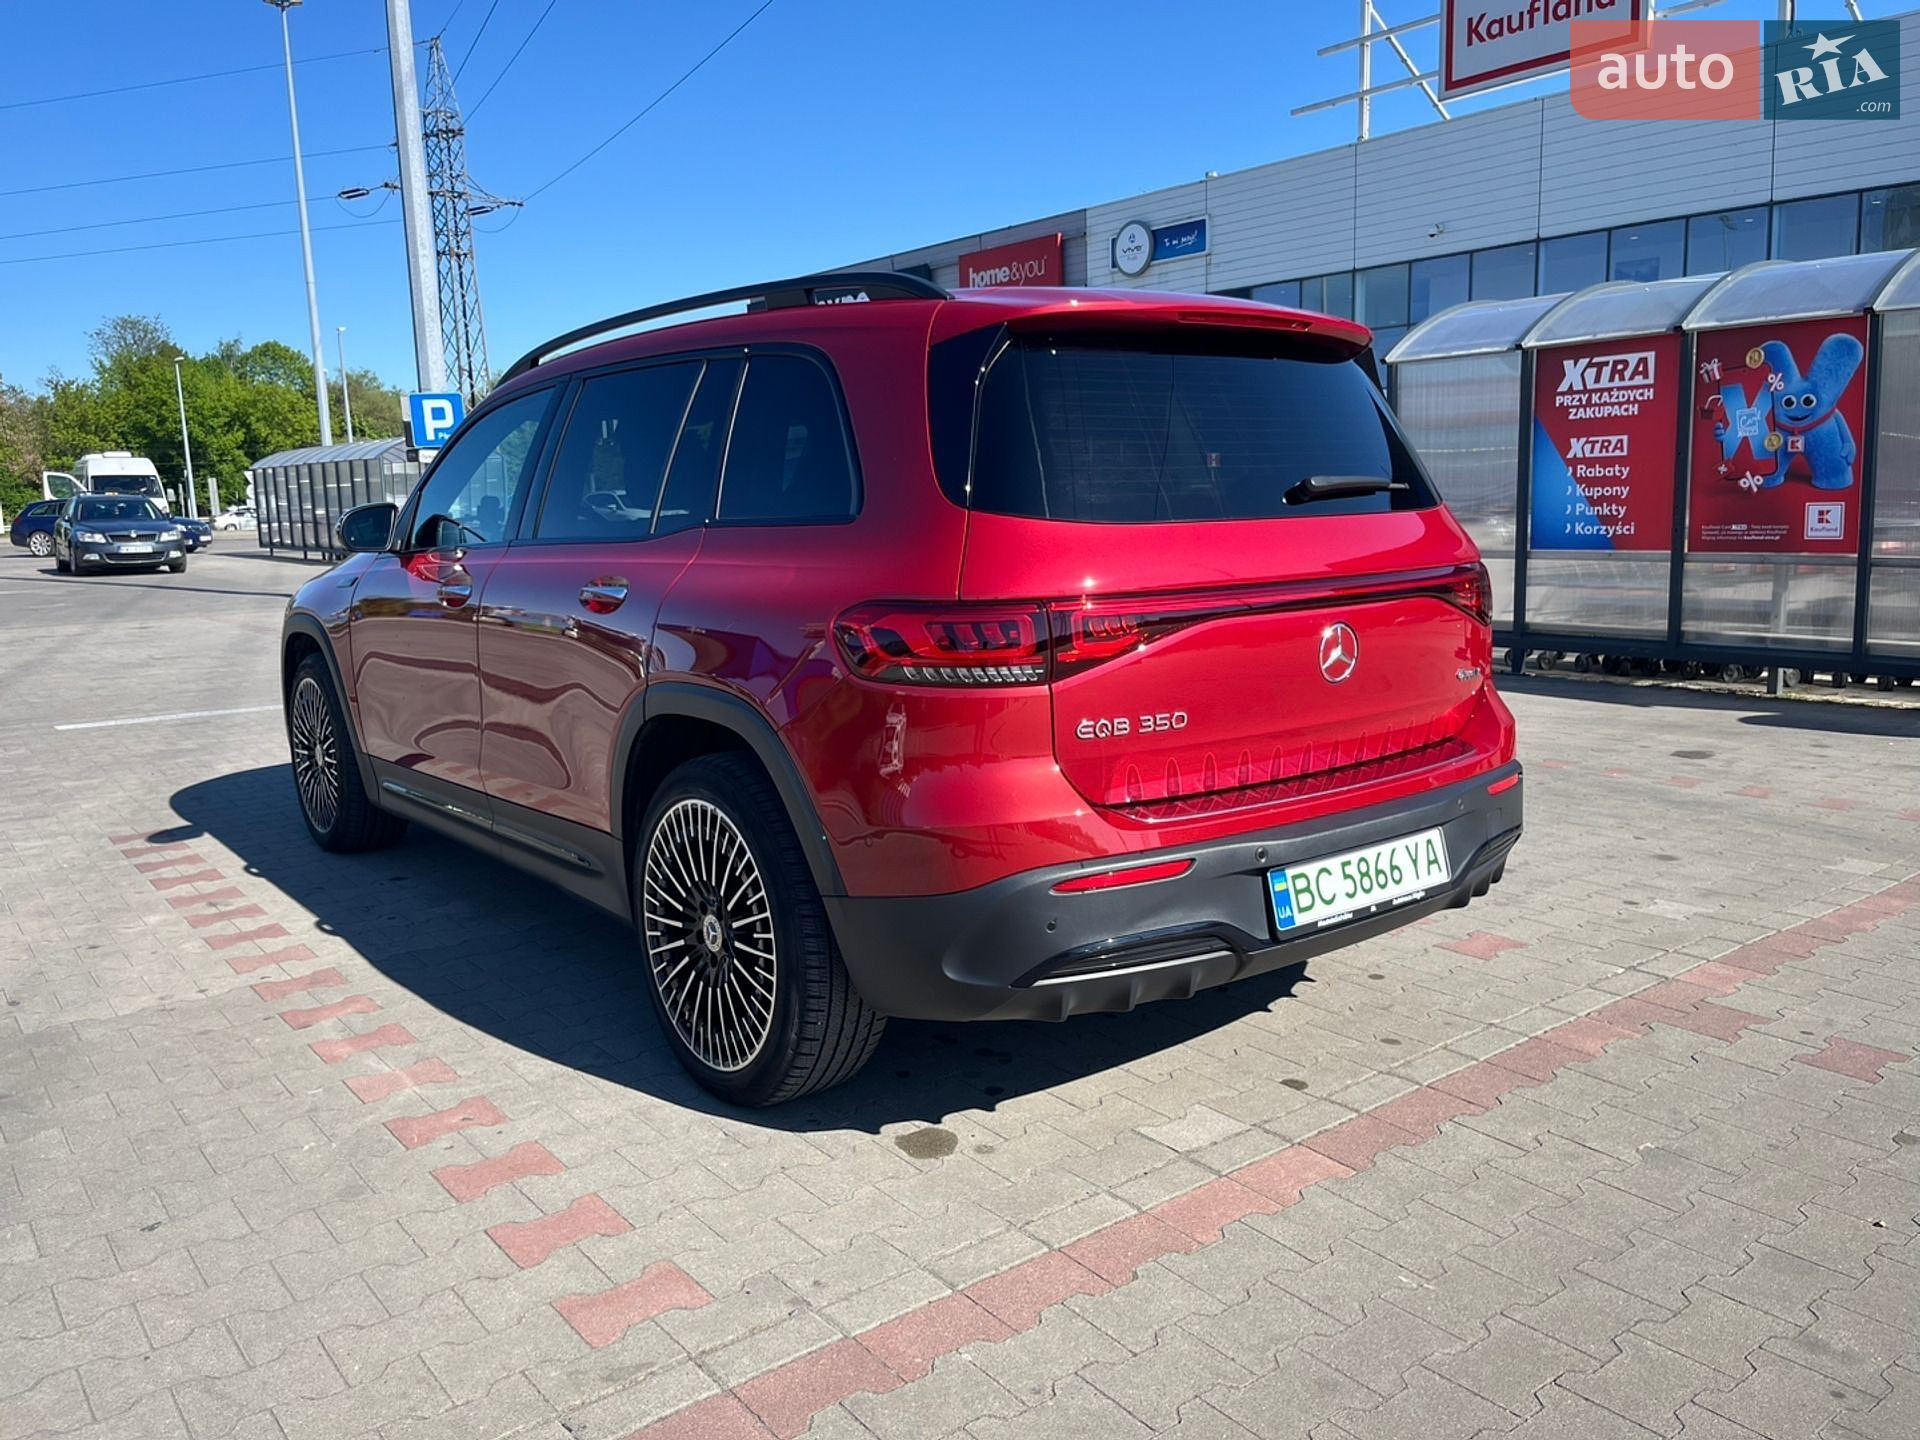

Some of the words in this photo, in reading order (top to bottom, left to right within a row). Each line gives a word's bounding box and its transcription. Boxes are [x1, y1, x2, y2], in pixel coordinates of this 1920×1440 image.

[1466, 0, 1616, 47] Kauflan
[1557, 354, 1653, 392] XTRA
[1555, 393, 1588, 407] PRZY
[1592, 388, 1654, 404] KAŻDYCH
[421, 398, 455, 441] P
[1568, 404, 1639, 419] ZAKUPACH
[1566, 436, 1627, 458] XTRA
[1576, 464, 1630, 479] Rabaty
[1576, 484, 1630, 499] Kupony
[1575, 502, 1627, 518] Punkty
[1575, 522, 1635, 537] Korzyści
[1076, 717, 1130, 738] EQB
[1139, 711, 1188, 733] 350
[1291, 867, 1337, 914] BC
[1340, 847, 1403, 899] 5866
[1405, 838, 1442, 881] YA
[1278, 906, 1292, 919] UA
